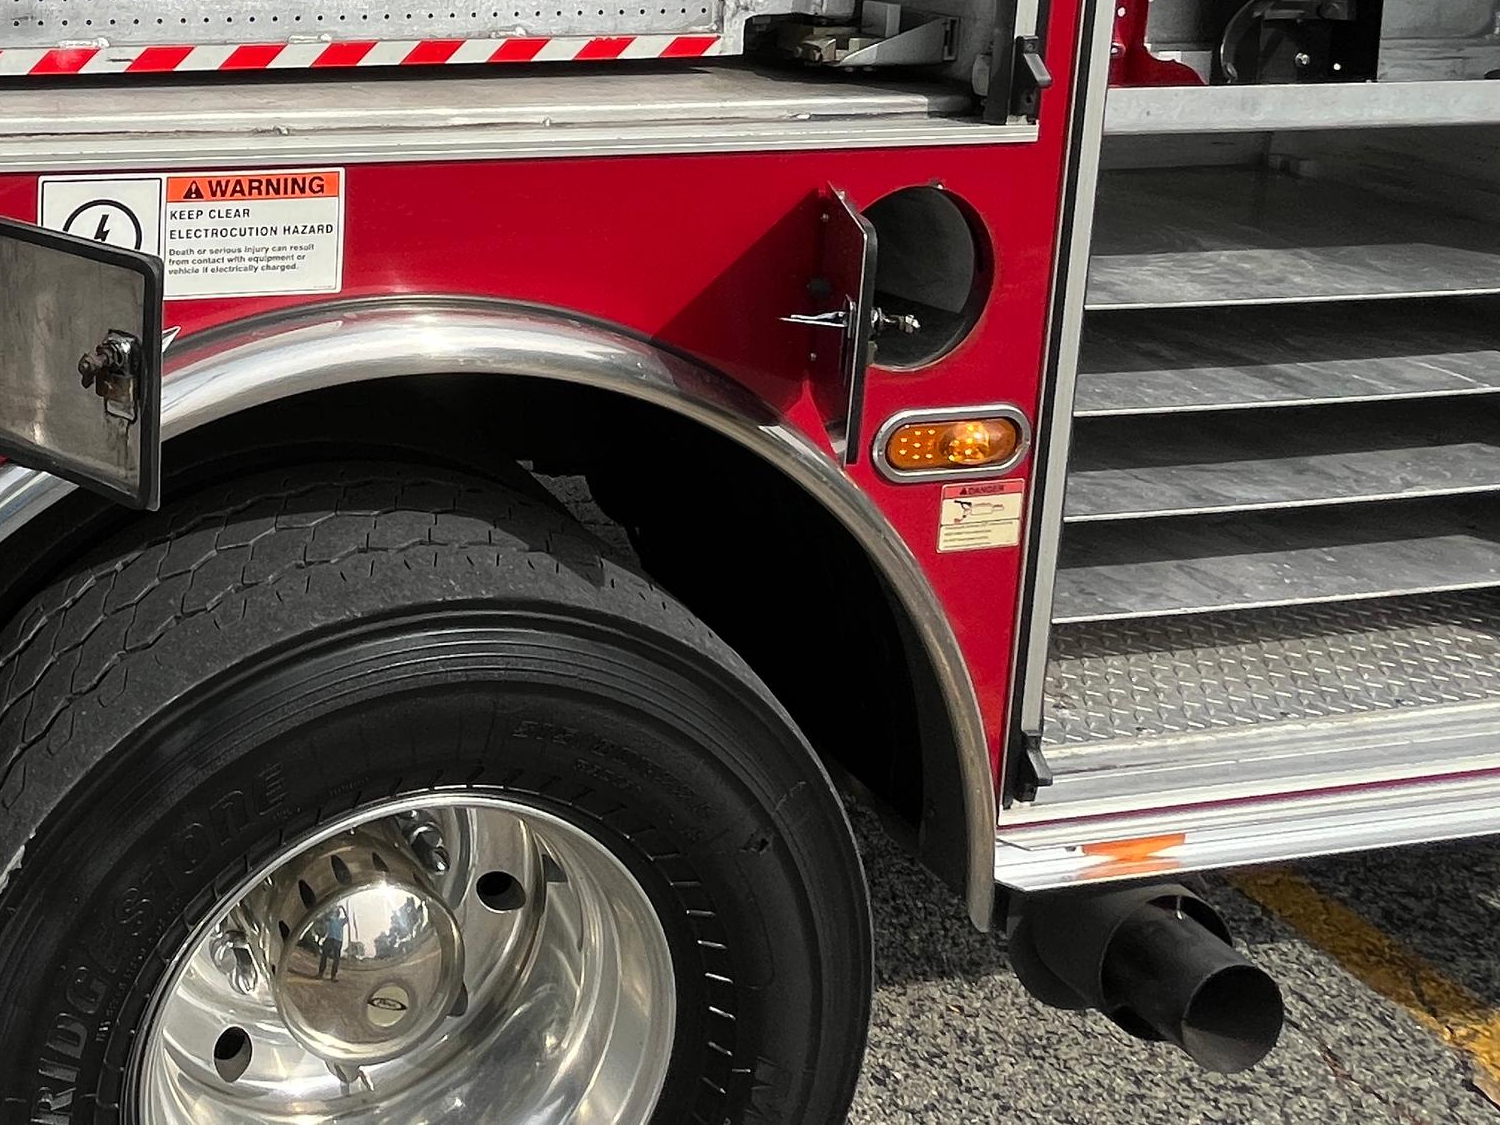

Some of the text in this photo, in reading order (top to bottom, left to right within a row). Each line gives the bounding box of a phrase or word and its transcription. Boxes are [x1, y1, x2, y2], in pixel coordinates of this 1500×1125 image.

[208, 176, 325, 198] WARNING
[170, 208, 251, 220] KEEP CLEAR
[169, 224, 334, 240] ELECTROCUTION HAZARD
[169, 248, 195, 256] Death
[244, 246, 269, 254] injury
[168, 258, 189, 266] from
[191, 257, 225, 265] contact
[227, 255, 245, 263] with
[247, 254, 295, 264] equipment
[168, 266, 200, 275] vehicle
